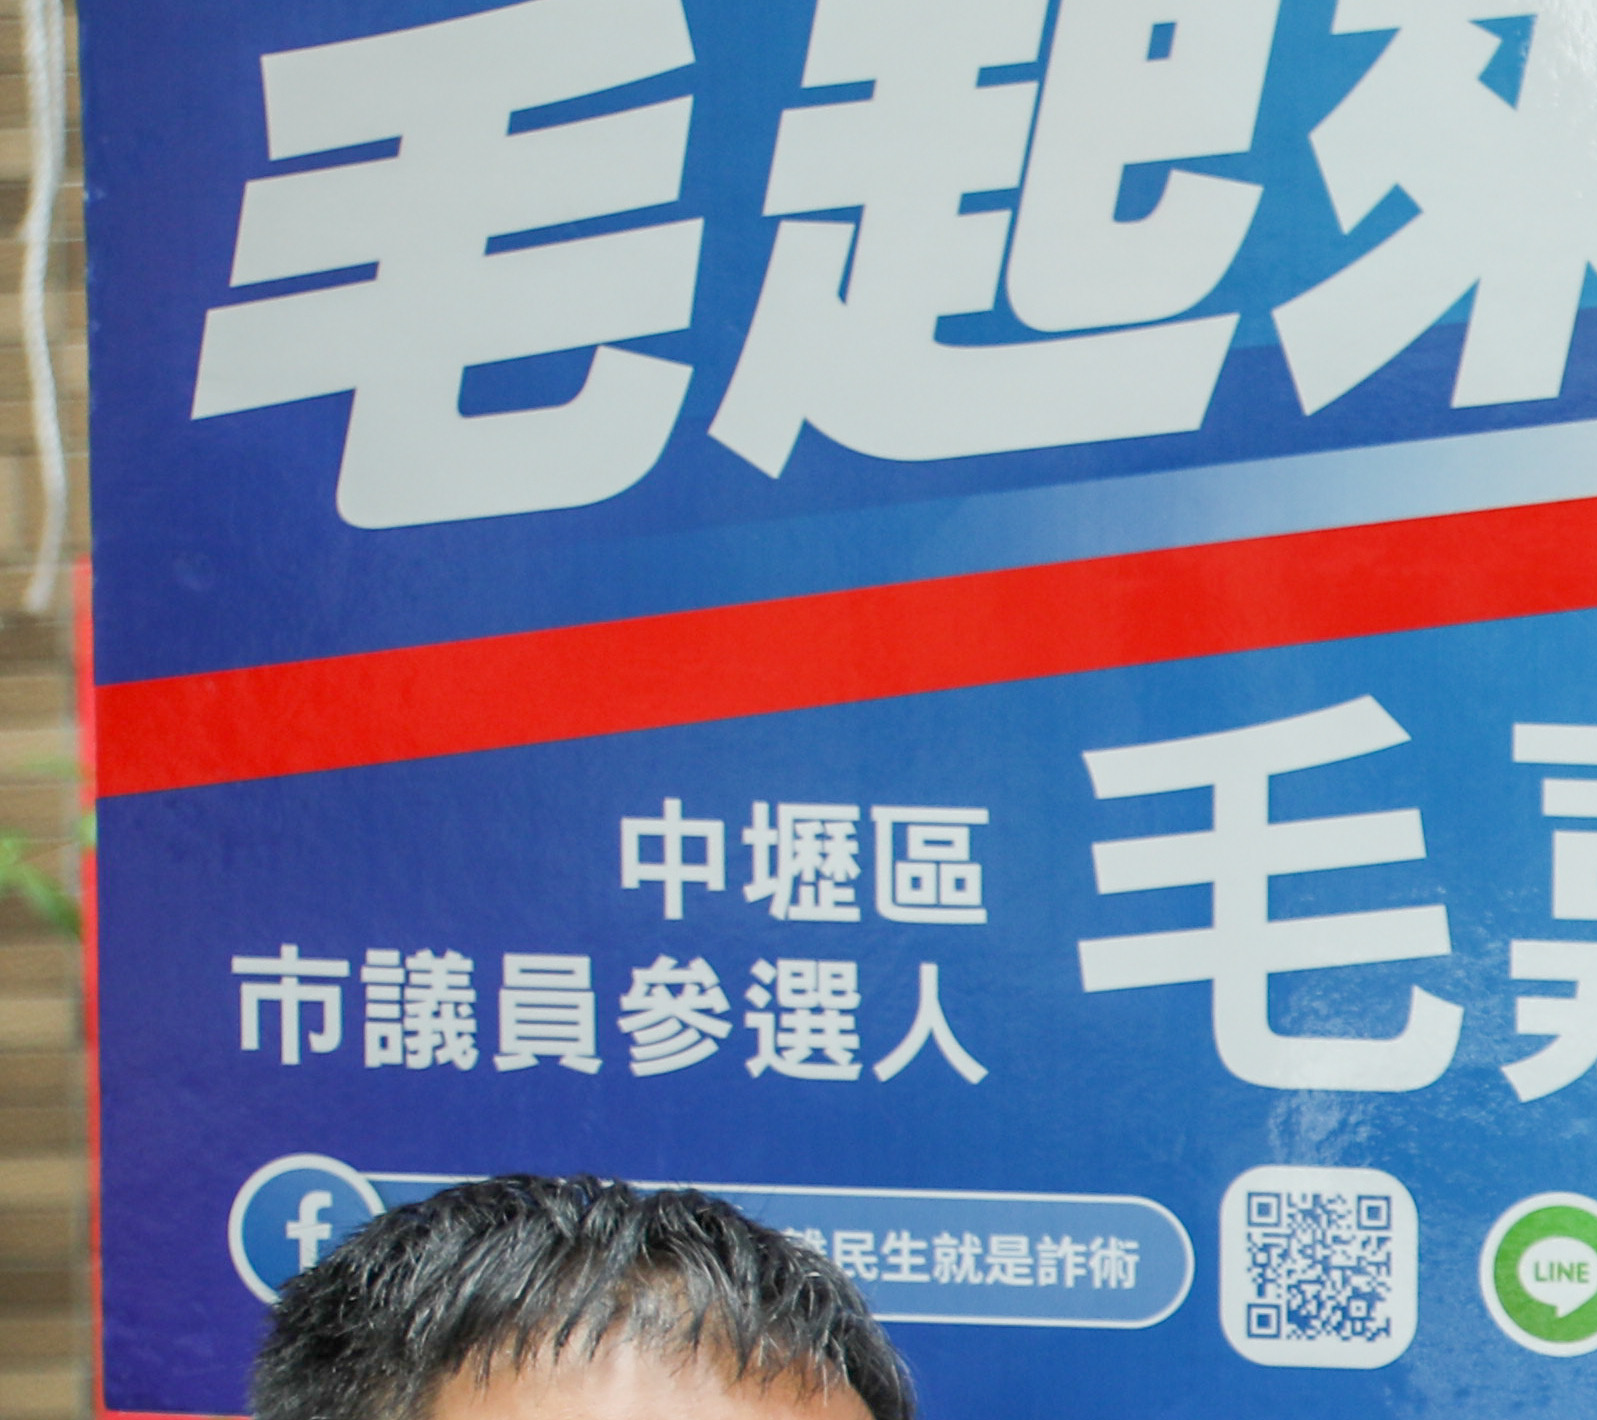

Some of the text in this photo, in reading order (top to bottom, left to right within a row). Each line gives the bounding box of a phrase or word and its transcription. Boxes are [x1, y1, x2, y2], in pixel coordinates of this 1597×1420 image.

[619, 797, 989, 925] 中壢區
[230, 943, 988, 1084] 市議員參選人
[1533, 1259, 1590, 1287] LINE
